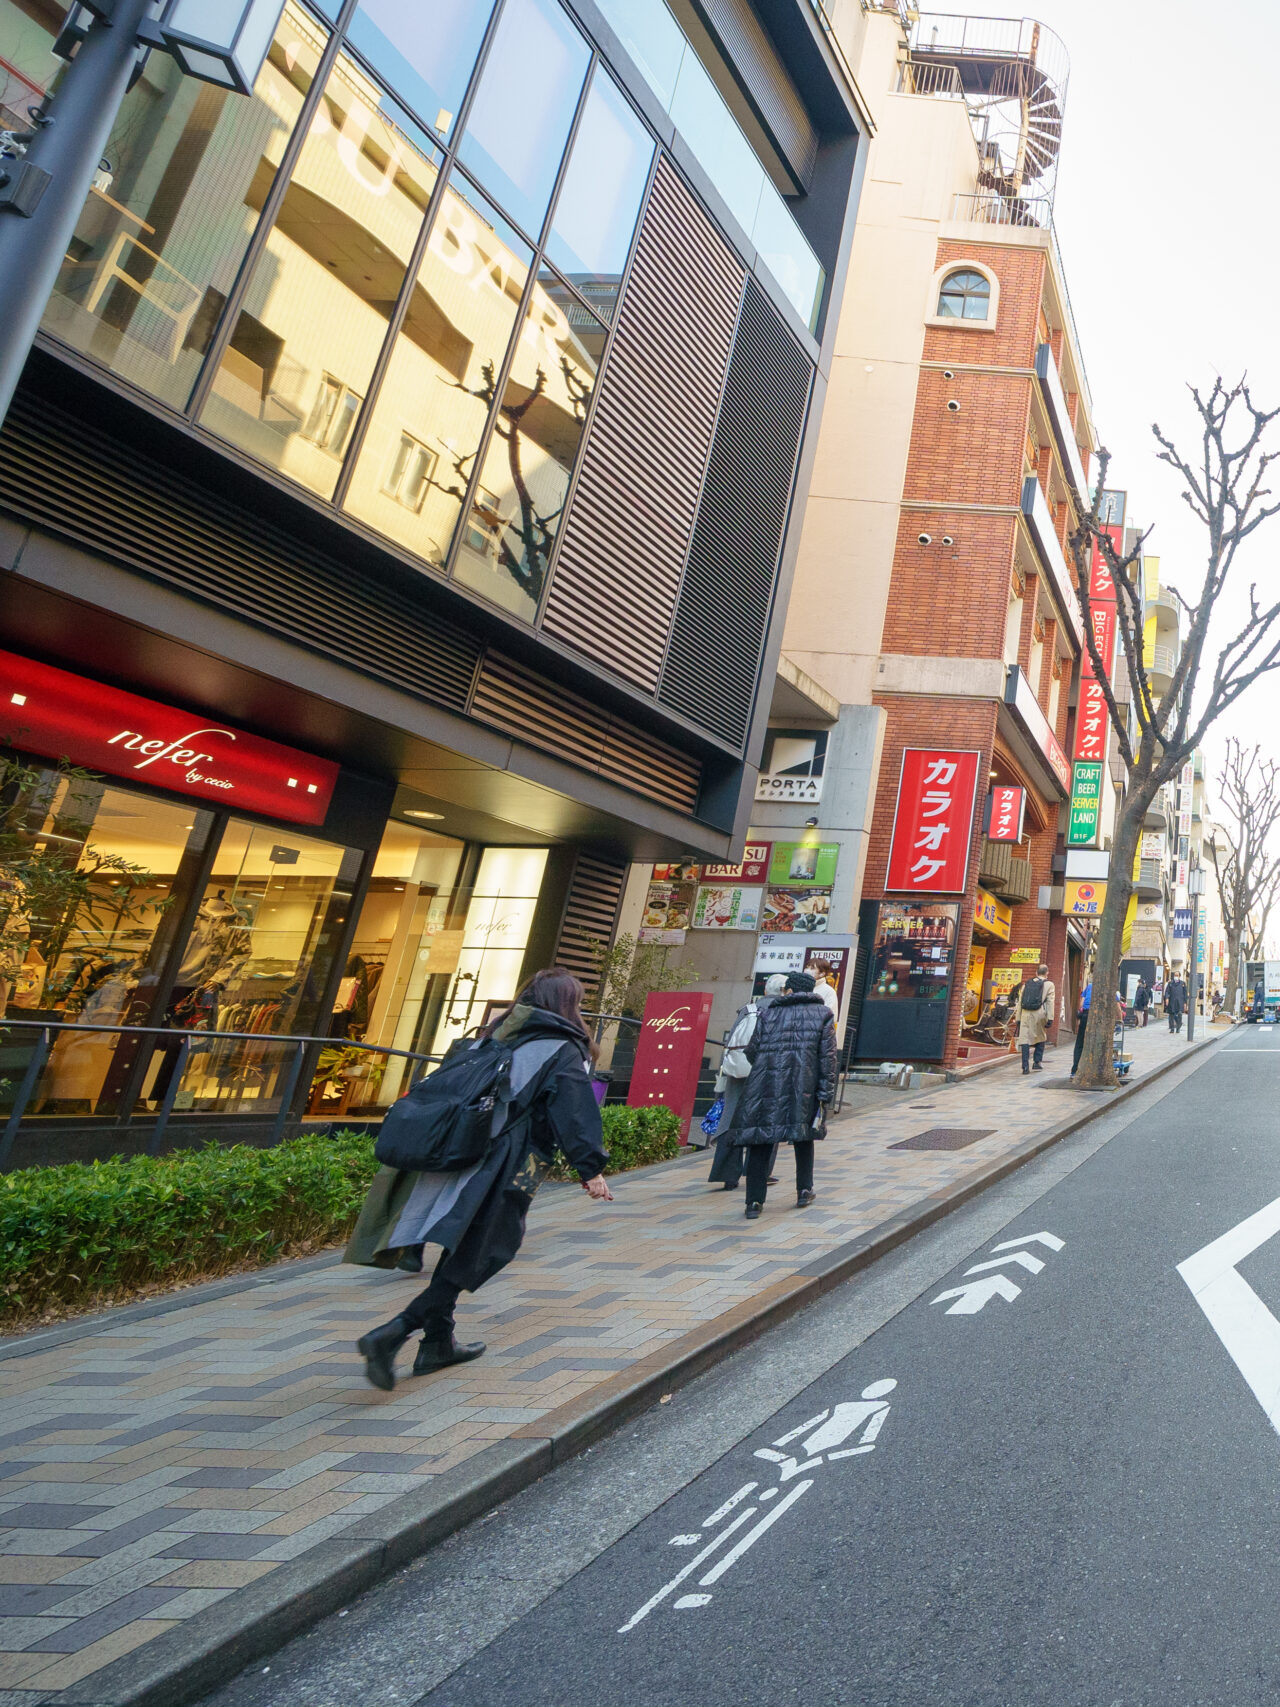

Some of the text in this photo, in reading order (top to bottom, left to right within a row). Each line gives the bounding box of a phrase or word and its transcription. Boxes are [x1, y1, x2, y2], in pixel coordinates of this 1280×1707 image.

[1083, 683, 1103, 751] カラオケ
[107, 728, 236, 769] nefer
[186, 768, 203, 783] by
[1077, 768, 1100, 780] CRAFT
[760, 778, 817, 790] PORTA
[1078, 784, 1096, 794] BEER
[1072, 798, 1098, 809] SERVER
[997, 790, 1014, 838] カラオケ
[1074, 812, 1095, 823] LAND
[910, 758, 958, 883] カラオケ
[708, 864, 739, 875] BAR
[1072, 901, 1097, 913] 松屋
[881, 920, 924, 929] SERVER
[762, 935, 775, 945] 2F
[647, 1007, 690, 1032] nefer
